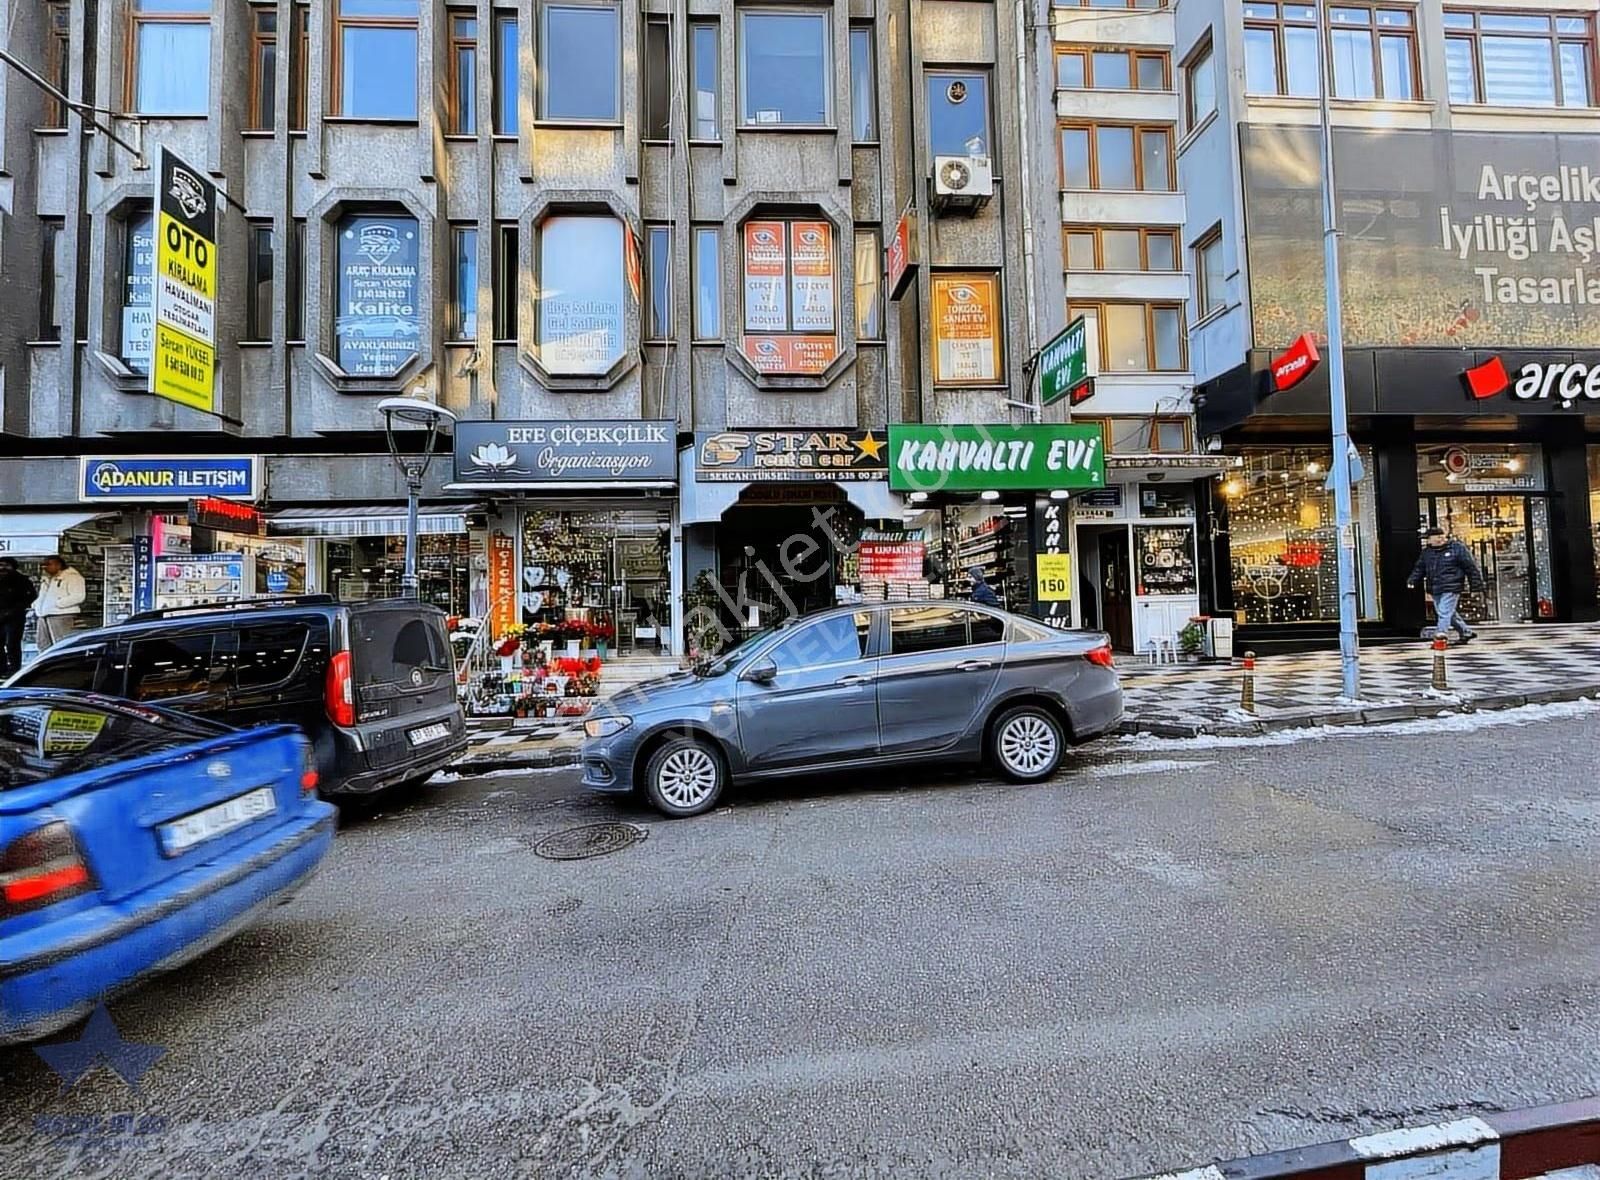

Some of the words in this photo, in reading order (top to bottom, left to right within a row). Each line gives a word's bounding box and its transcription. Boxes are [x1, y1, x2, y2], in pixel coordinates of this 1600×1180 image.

[1478, 165, 1600, 211] Arçelik
[167, 221, 207, 268] OTO
[1439, 206, 1539, 260] İyiliği
[168, 258, 207, 294] KIRALAMA
[1474, 266, 1600, 305] Tasarla
[349, 302, 414, 316] Kalite
[947, 304, 983, 314] TOKGÖZ
[1041, 327, 1085, 377] KAHVALTI
[508, 427, 547, 443] EFE
[550, 424, 669, 446] ÇİÇEKÇİLİK
[754, 433, 855, 452] STAR
[537, 446, 653, 477] Organizasyon
[754, 452, 795, 467] rent
[798, 454, 813, 466] a
[818, 454, 855, 467] car
[897, 439, 1034, 471] KAHVALTI
[100, 471, 174, 486] ADANUR
[178, 469, 246, 488] İLETİŞİM
[1091, 471, 1099, 482] 2
[1040, 578, 1065, 593] 150
